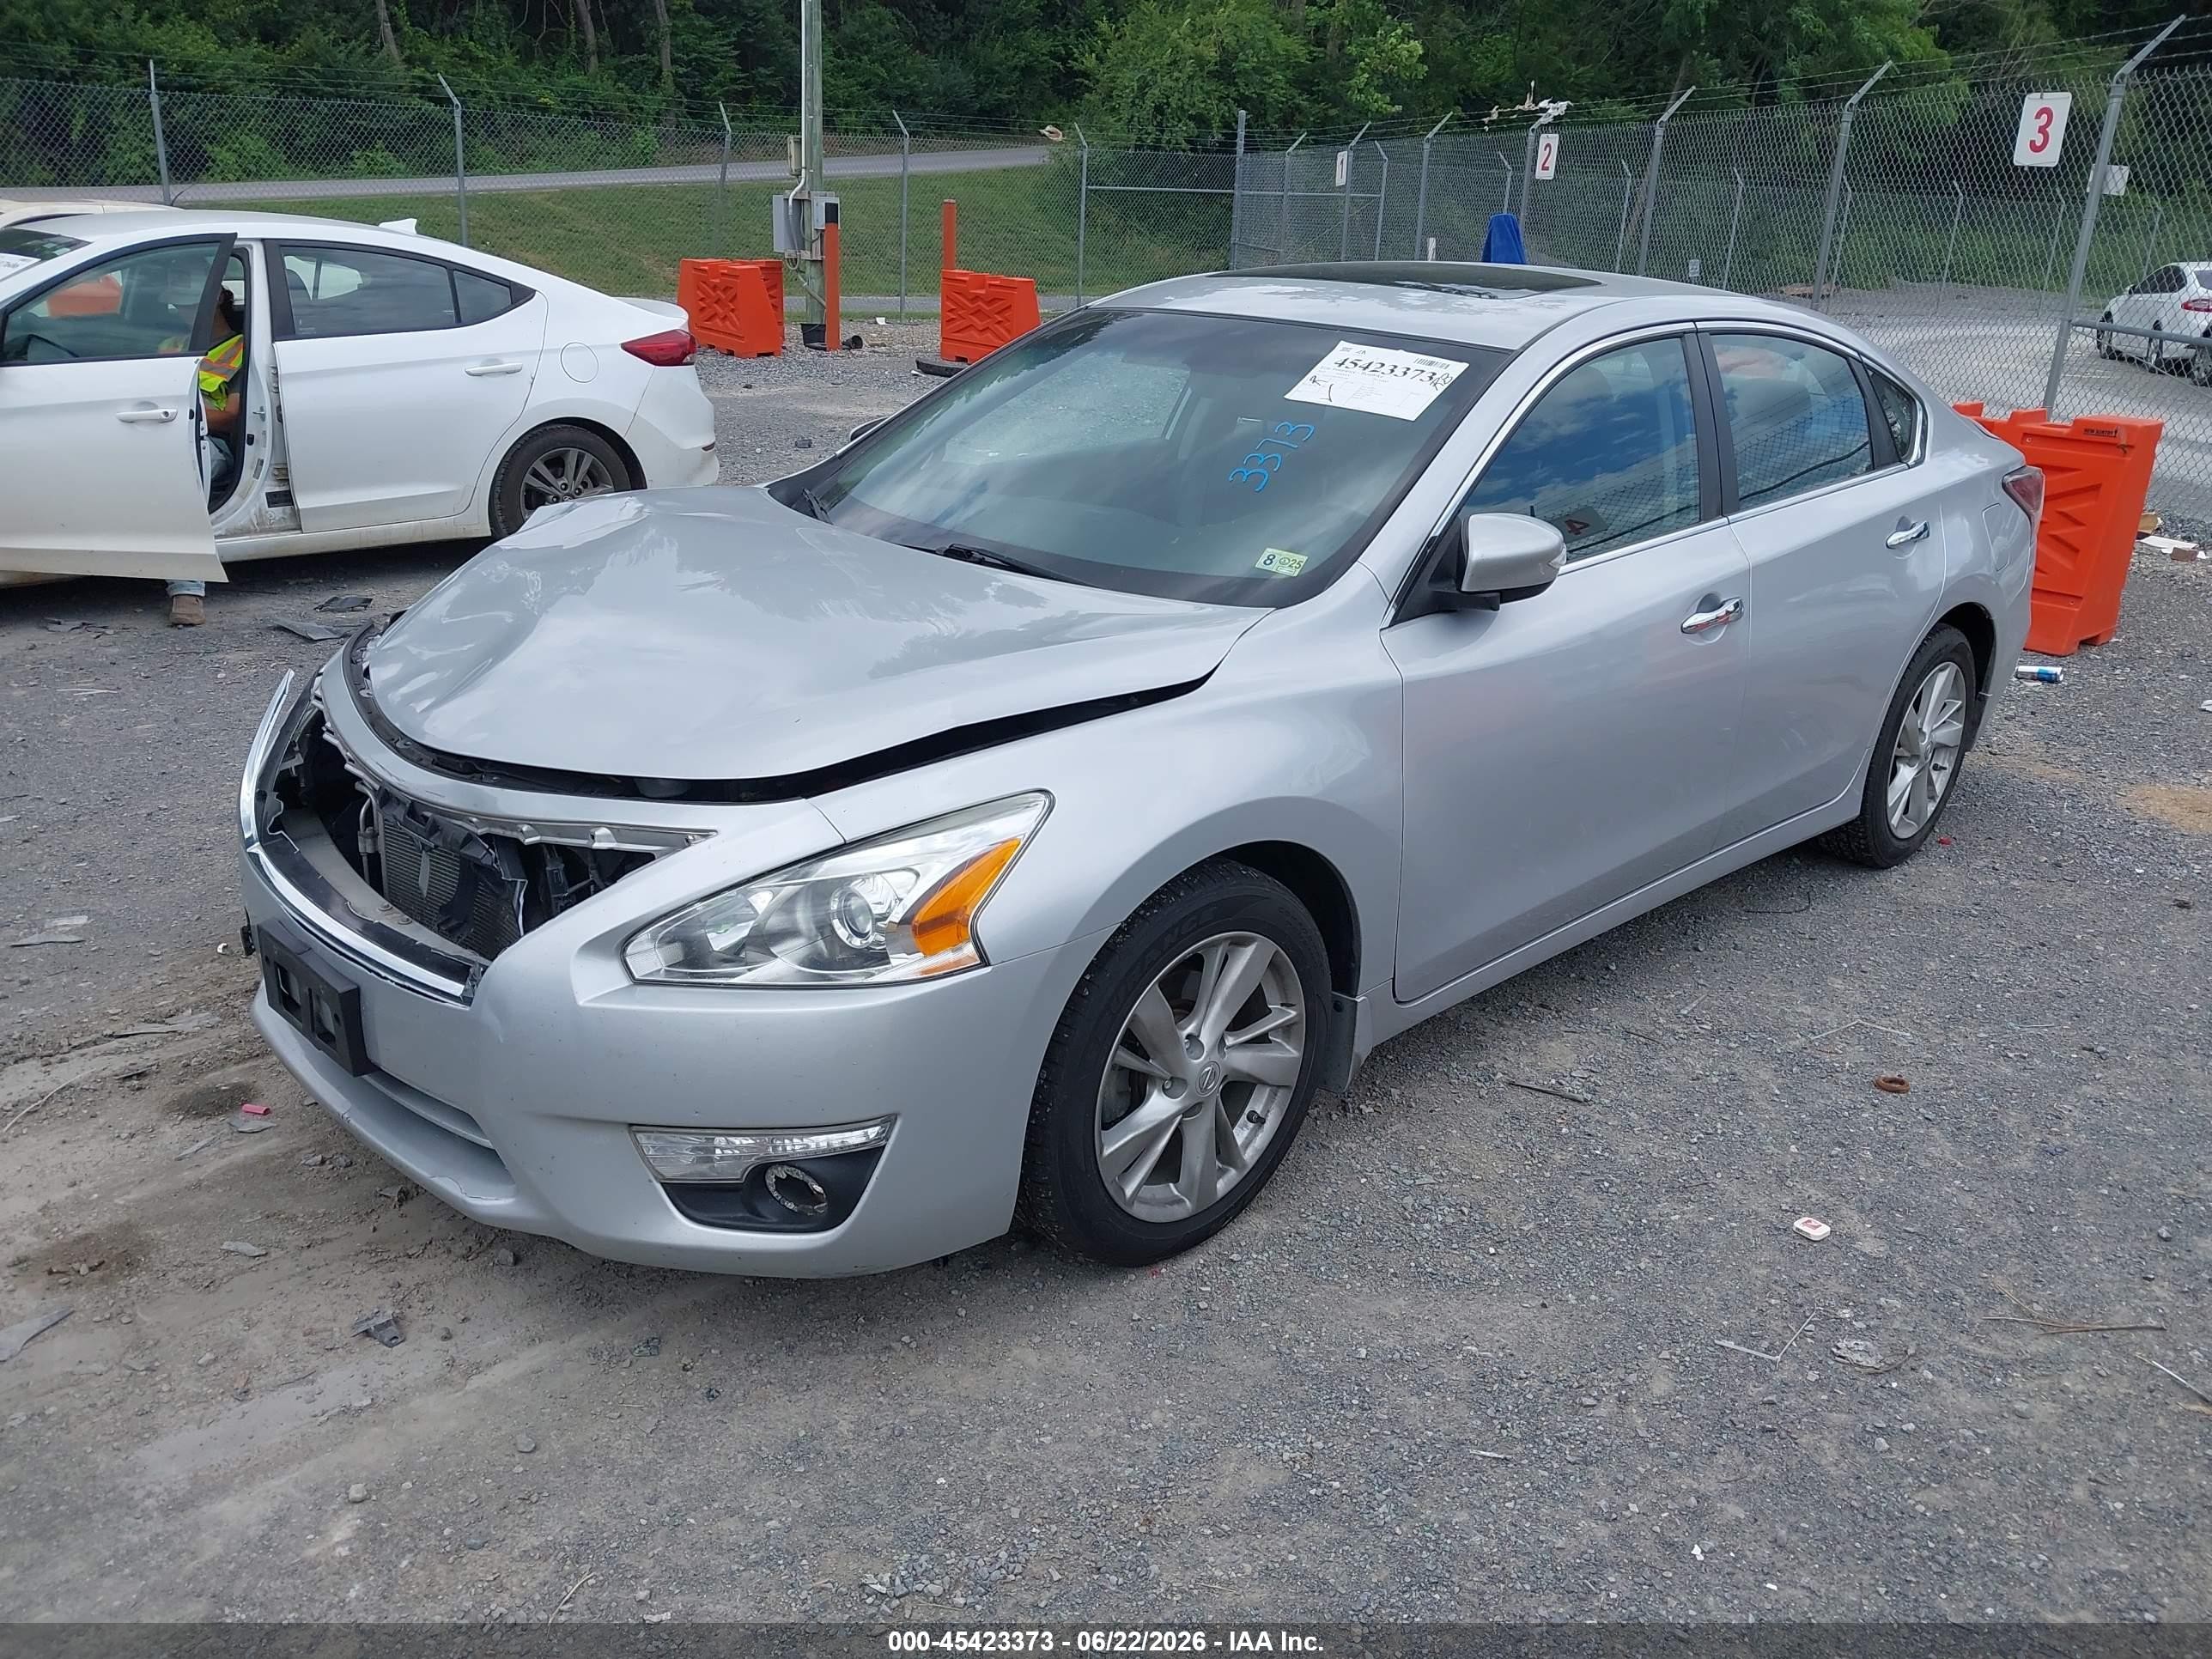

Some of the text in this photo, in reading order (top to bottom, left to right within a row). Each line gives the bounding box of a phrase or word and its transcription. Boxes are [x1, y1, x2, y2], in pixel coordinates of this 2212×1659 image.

[2029, 106, 2054, 153] 3
[1541, 143, 1553, 171] 2
[1334, 356, 1437, 382] 45423373
[1263, 554, 1276, 566] 8
[1288, 559, 1304, 569] 25
